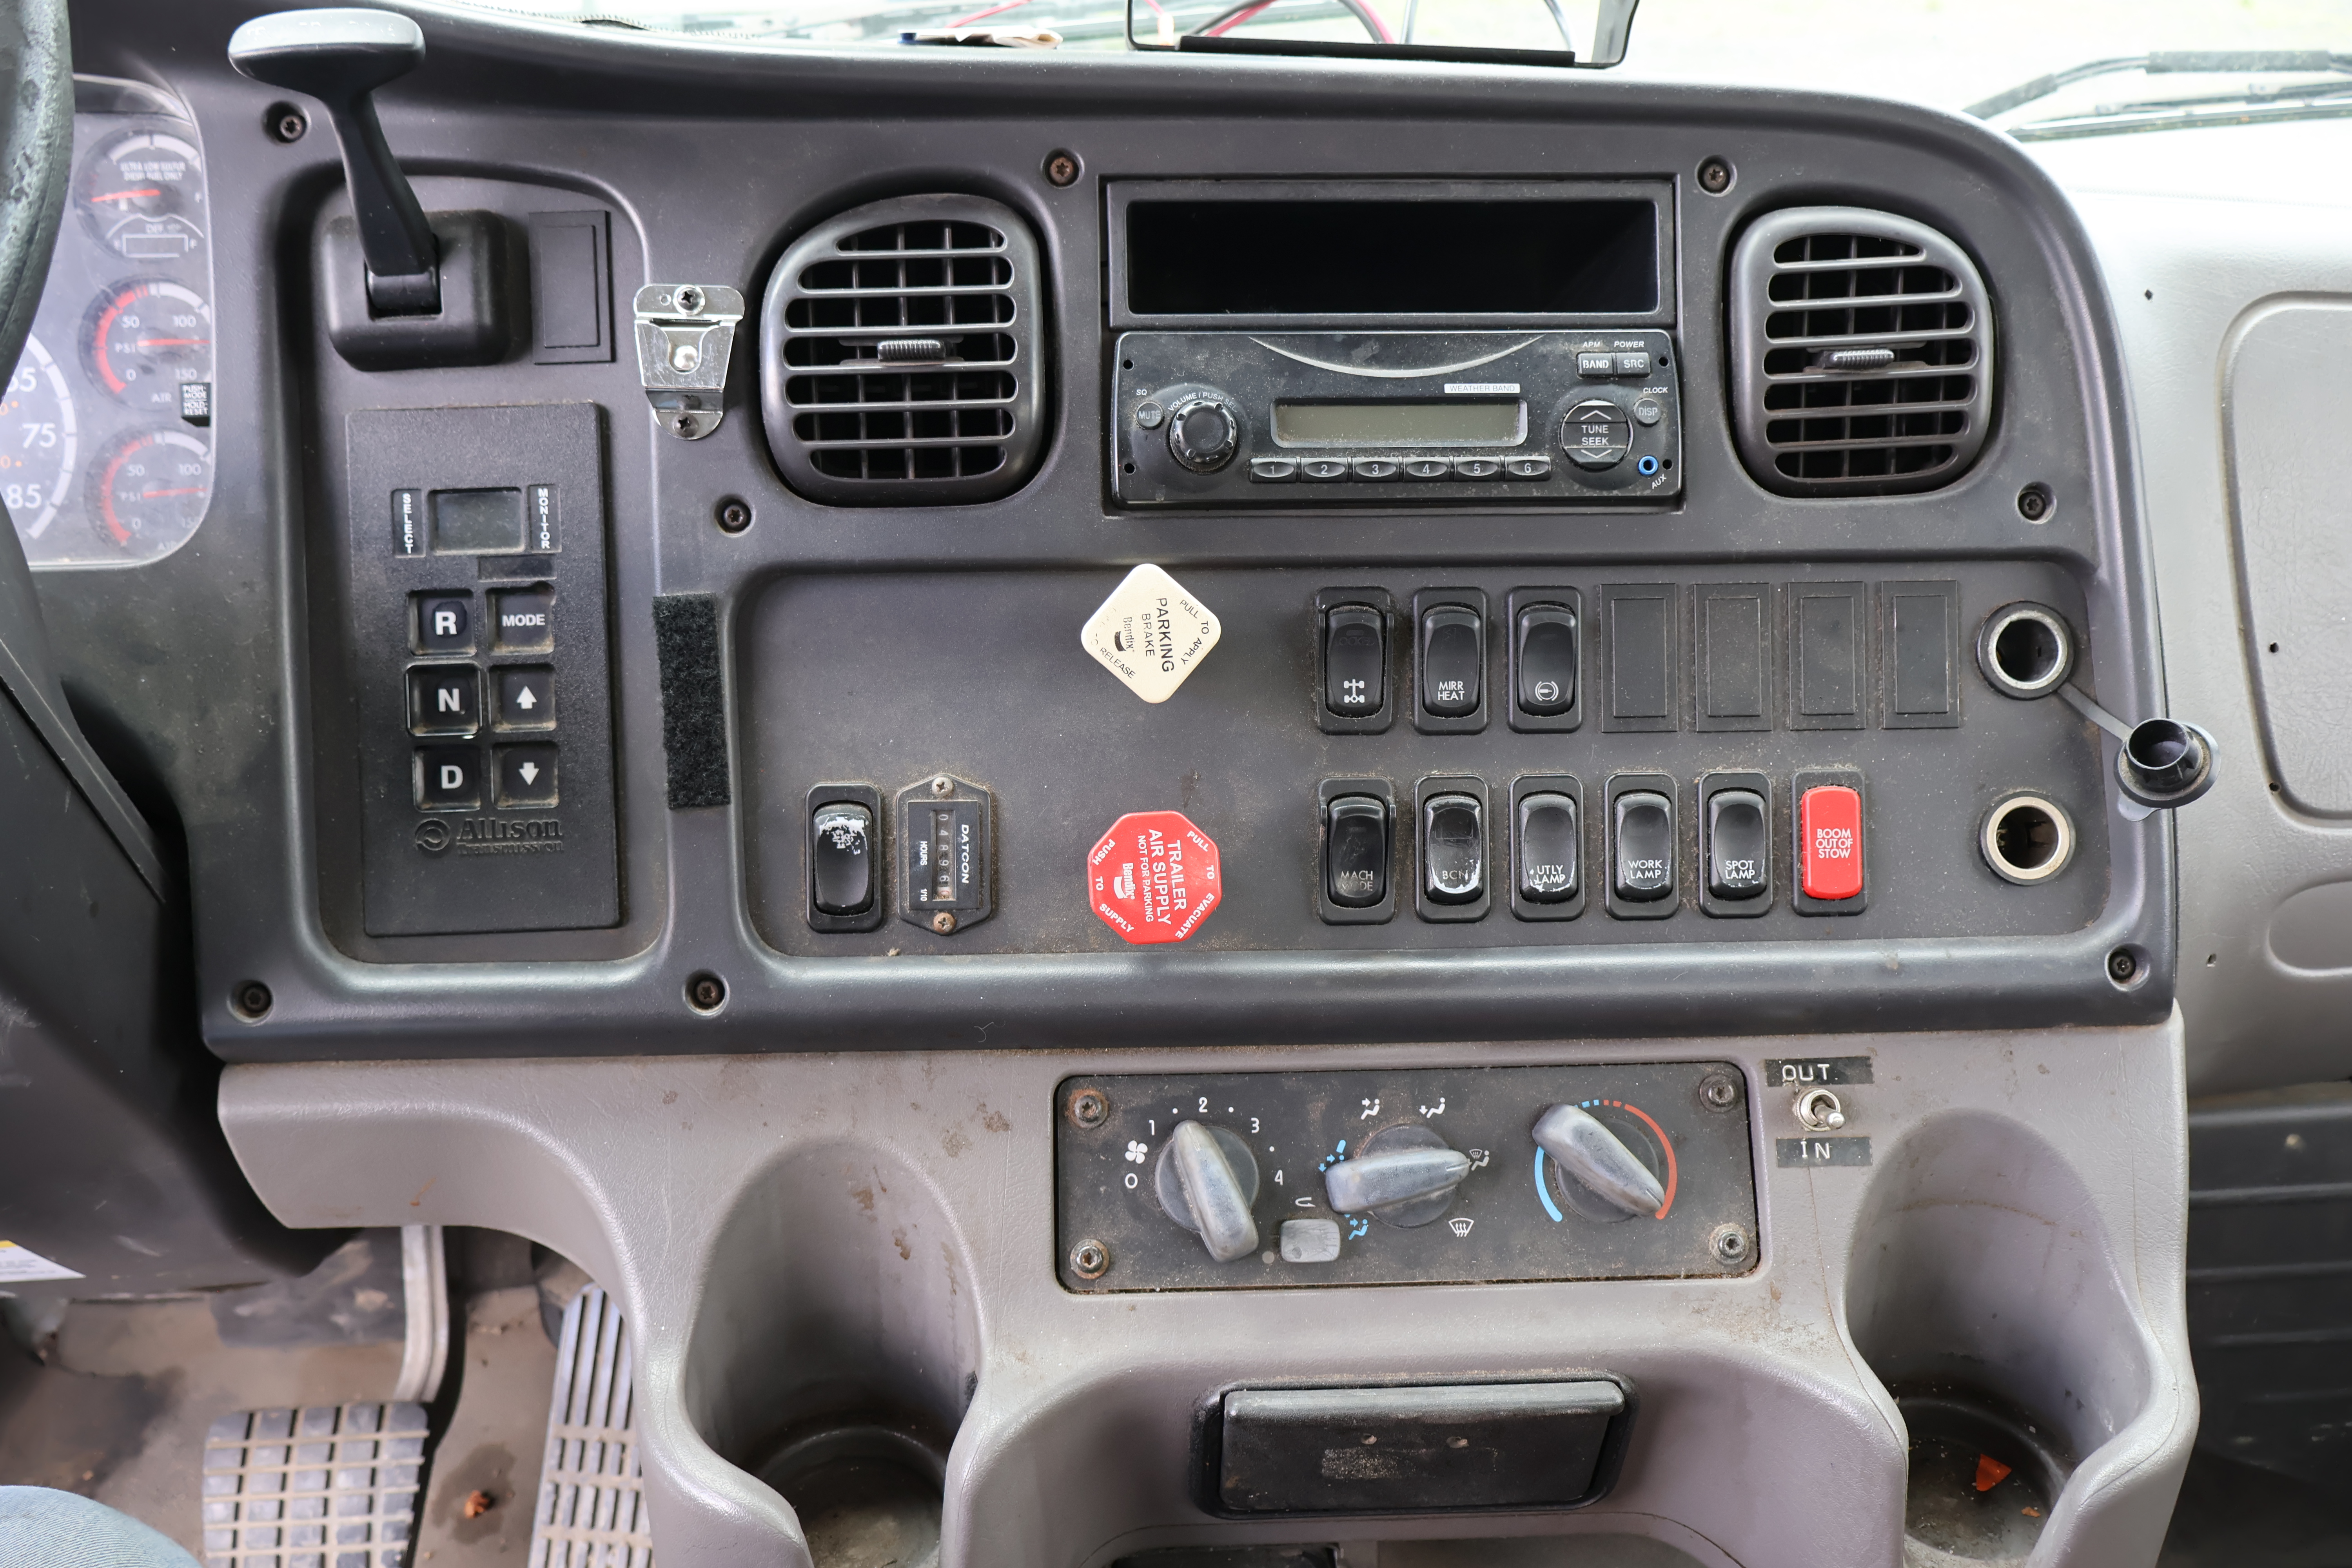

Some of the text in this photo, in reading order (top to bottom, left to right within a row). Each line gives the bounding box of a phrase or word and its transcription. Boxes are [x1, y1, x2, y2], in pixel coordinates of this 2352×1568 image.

[121, 315, 140, 328] 50
[172, 315, 196, 328] 100
[1583, 360, 1609, 368] BAND
[1624, 359, 1644, 368] SRC
[125, 368, 136, 381] 0
[175, 368, 197, 380] 150
[151, 392, 172, 403] AIR
[1168, 393, 1197, 412] VOLUME
[1203, 392, 1223, 401] PUSH
[1138, 410, 1161, 420] MUTE
[1639, 406, 1658, 416] DISP
[22, 423, 57, 448] 75
[1582, 425, 1609, 434] TUNE
[1582, 437, 1609, 445] SEEK
[126, 464, 145, 477] 50
[179, 463, 201, 475] 100
[1269, 465, 1275, 475] 1
[1321, 465, 1328, 474] 2
[1372, 465, 1379, 474] 3
[1422, 464, 1430, 474] 4
[1473, 464, 1481, 474] 5
[1524, 463, 1531, 473] 6
[1651, 474, 1666, 489] AUX
[6, 483, 42, 509] 85
[403, 493, 414, 554] SELECT
[537, 488, 551, 549] MONITOR
[435, 611, 457, 635] R
[502, 614, 546, 627] MODE
[1123, 616, 1135, 649] Bendix
[1142, 613, 1155, 657] BRAKE
[1156, 598, 1175, 672] PARKING
[1180, 599, 1209, 665] PULL TO APPLY
[1100, 647, 1136, 679] RELEASE
[1439, 681, 1464, 691] MIRR
[438, 688, 460, 712] N
[1437, 691, 1465, 701] HEAT
[441, 765, 463, 789] D
[456, 817, 563, 839] Allison
[1817, 828, 1851, 838] BOOM
[1815, 838, 1853, 849] OUT OF
[960, 824, 969, 884] DATCON
[1818, 848, 1851, 859] STOW
[1537, 864, 1564, 875] UTLY
[1628, 860, 1662, 869] WORK
[1725, 860, 1754, 870] SPOT
[1138, 835, 1154, 922] NOT FOR PARKING
[1149, 829, 1172, 925] AIR SUPPLY
[1167, 839, 1187, 911] TRAILER
[1341, 870, 1373, 880] MACH
[1442, 870, 1468, 881] BCN
[1535, 874, 1566, 884] LAMP
[1630, 869, 1662, 879] LAMP
[1725, 869, 1755, 880] LAMP
[1092, 838, 1134, 933] PUSH TO SUPPLY
[1175, 830, 1215, 939] PULL TO EVACUATE
[1782, 1063, 1830, 1081] OUT
[1198, 1097, 1208, 1113] 2
[1149, 1120, 1156, 1135] 1
[1251, 1117, 1260, 1134] 3
[1800, 1141, 1830, 1159] IN
[1274, 1169, 1283, 1185] 4
